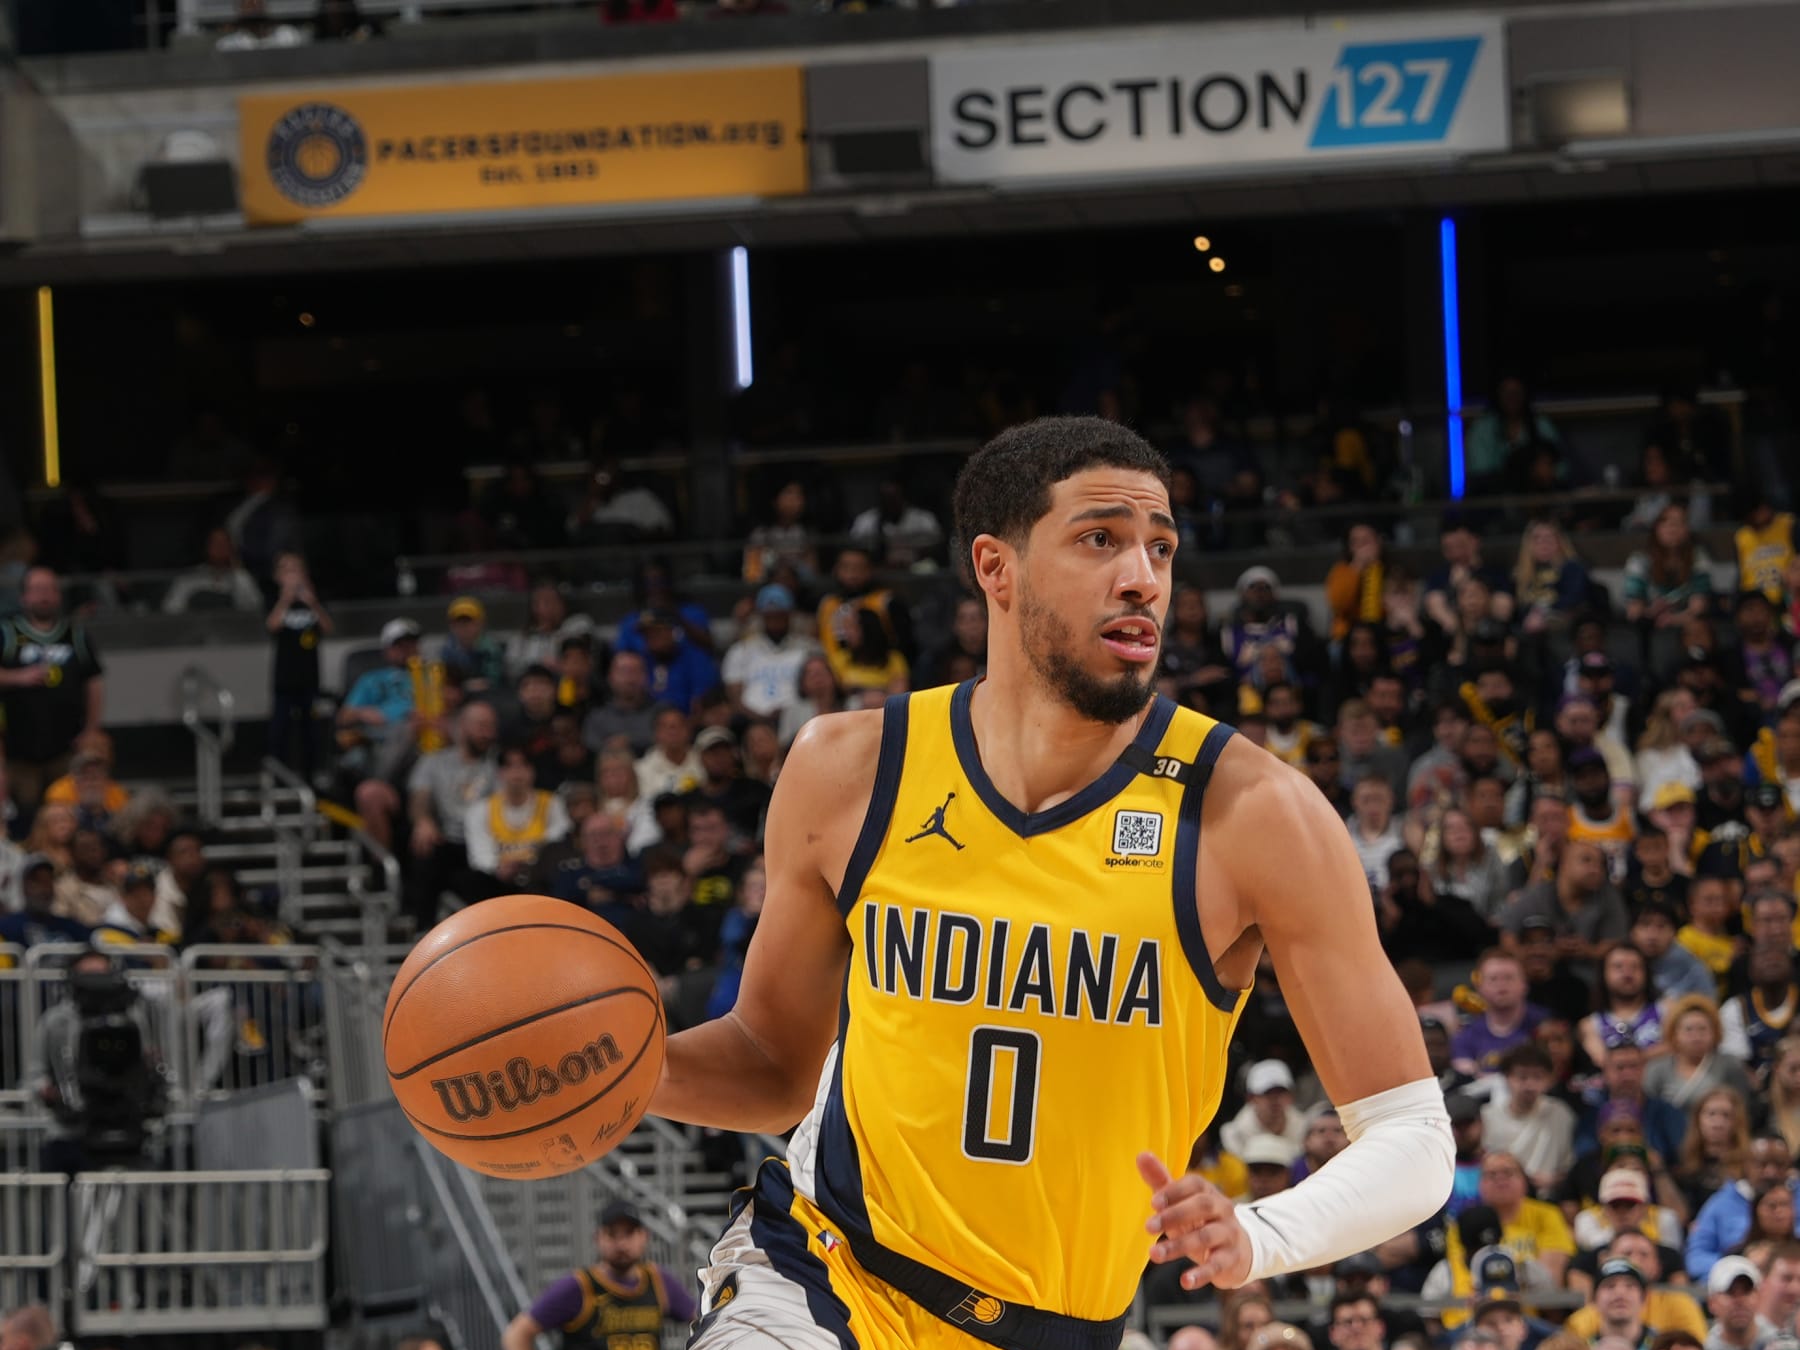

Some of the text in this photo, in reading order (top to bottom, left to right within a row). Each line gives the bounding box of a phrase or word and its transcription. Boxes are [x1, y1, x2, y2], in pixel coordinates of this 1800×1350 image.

[950, 58, 1453, 152] SECTION 127
[1153, 758, 1182, 778] 30
[1105, 856, 1164, 869] spokenote
[864, 901, 1162, 1028] INDIANA
[430, 1032, 624, 1123] Wilson
[960, 1024, 1043, 1166] 0
